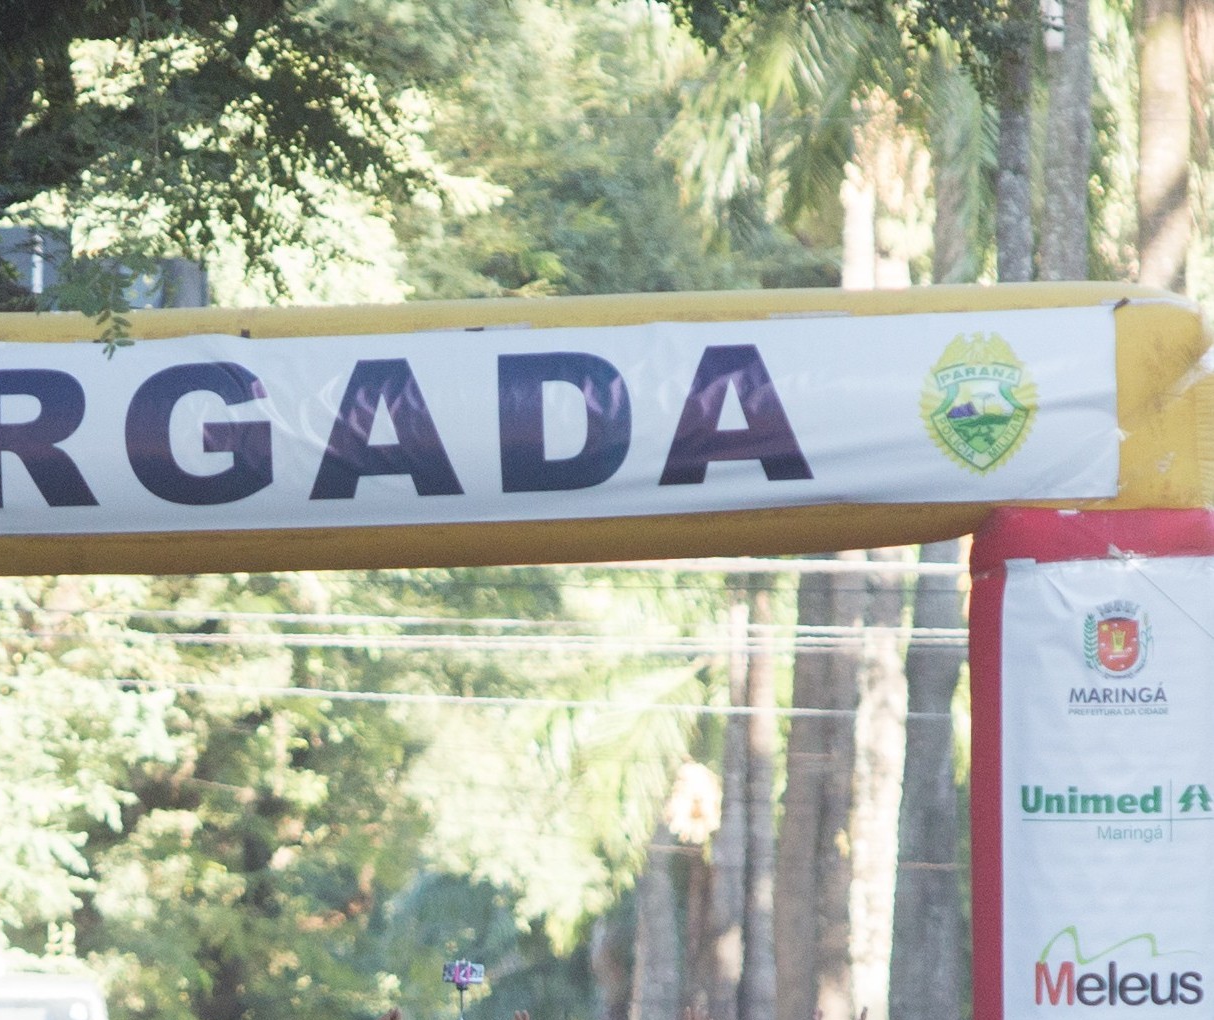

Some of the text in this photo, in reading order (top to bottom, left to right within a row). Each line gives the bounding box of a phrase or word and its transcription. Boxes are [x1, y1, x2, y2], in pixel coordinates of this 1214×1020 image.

[1068, 681, 1168, 704] MARINGÁ
[1020, 784, 1163, 814] Unimed
[1097, 825, 1163, 843] Maringá
[1034, 961, 1204, 1006] Meleus
